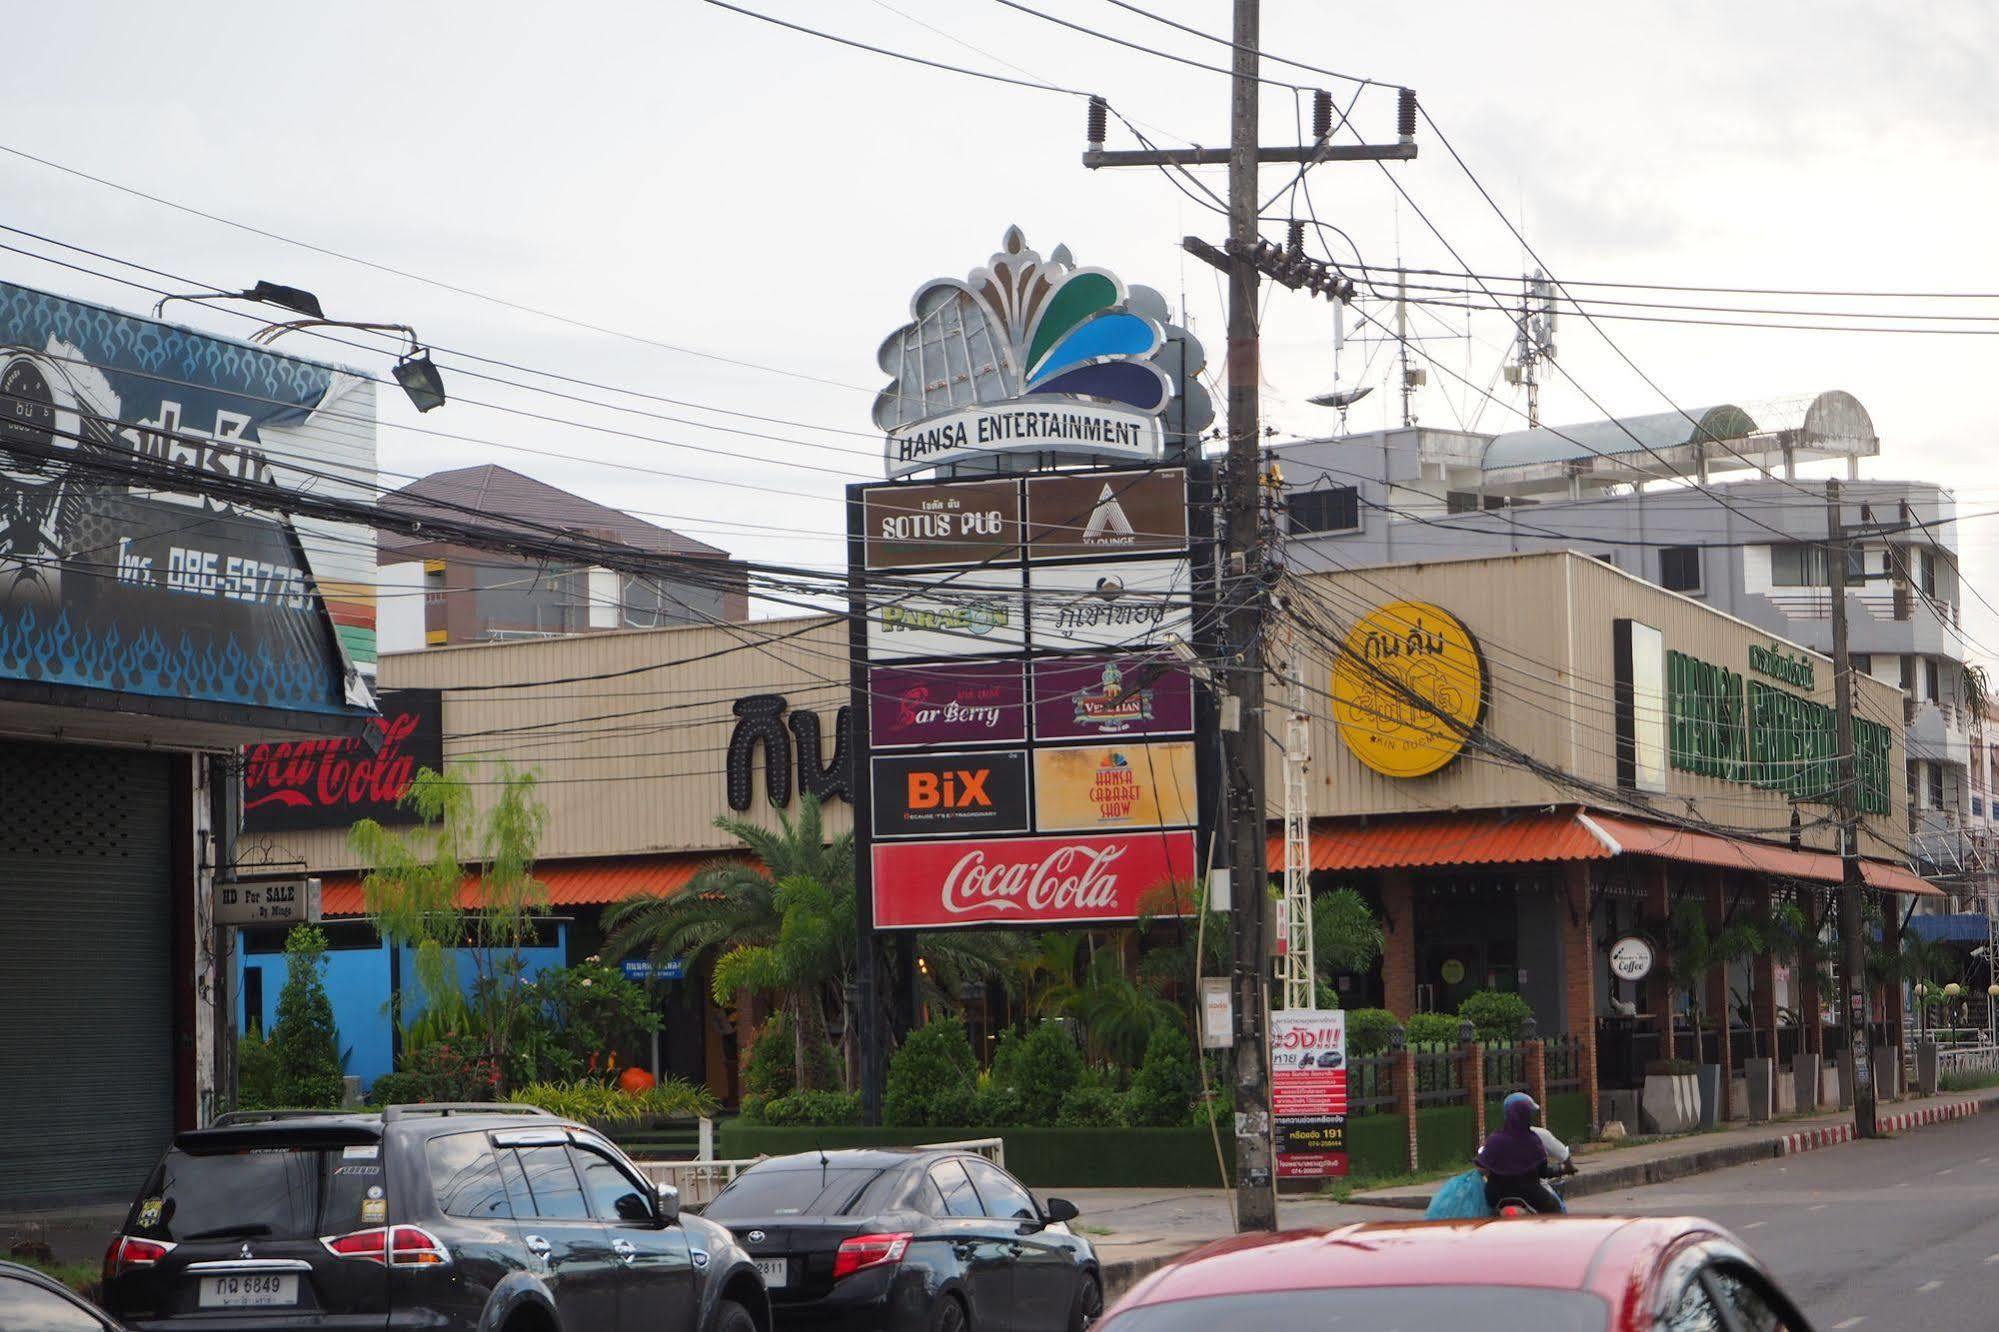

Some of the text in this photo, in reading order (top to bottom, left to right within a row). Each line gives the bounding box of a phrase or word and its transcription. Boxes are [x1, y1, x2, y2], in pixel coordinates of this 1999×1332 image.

[899, 411, 1142, 462] HANSA ENTERTAINMENT
[882, 510, 1002, 540] SOTUS PUB
[943, 700, 1000, 728] Berry
[1095, 770, 1133, 786] HANSA
[907, 769, 993, 810] BiX
[1089, 785, 1142, 803] CABARET
[1100, 800, 1131, 818] SHOW
[940, 844, 1128, 914] Coca-Cola
[222, 887, 295, 904] HD For SALE
[1618, 960, 1644, 973] Coffee
[1323, 1128, 1343, 1139] 191
[243, 1277, 281, 1293] 6849
